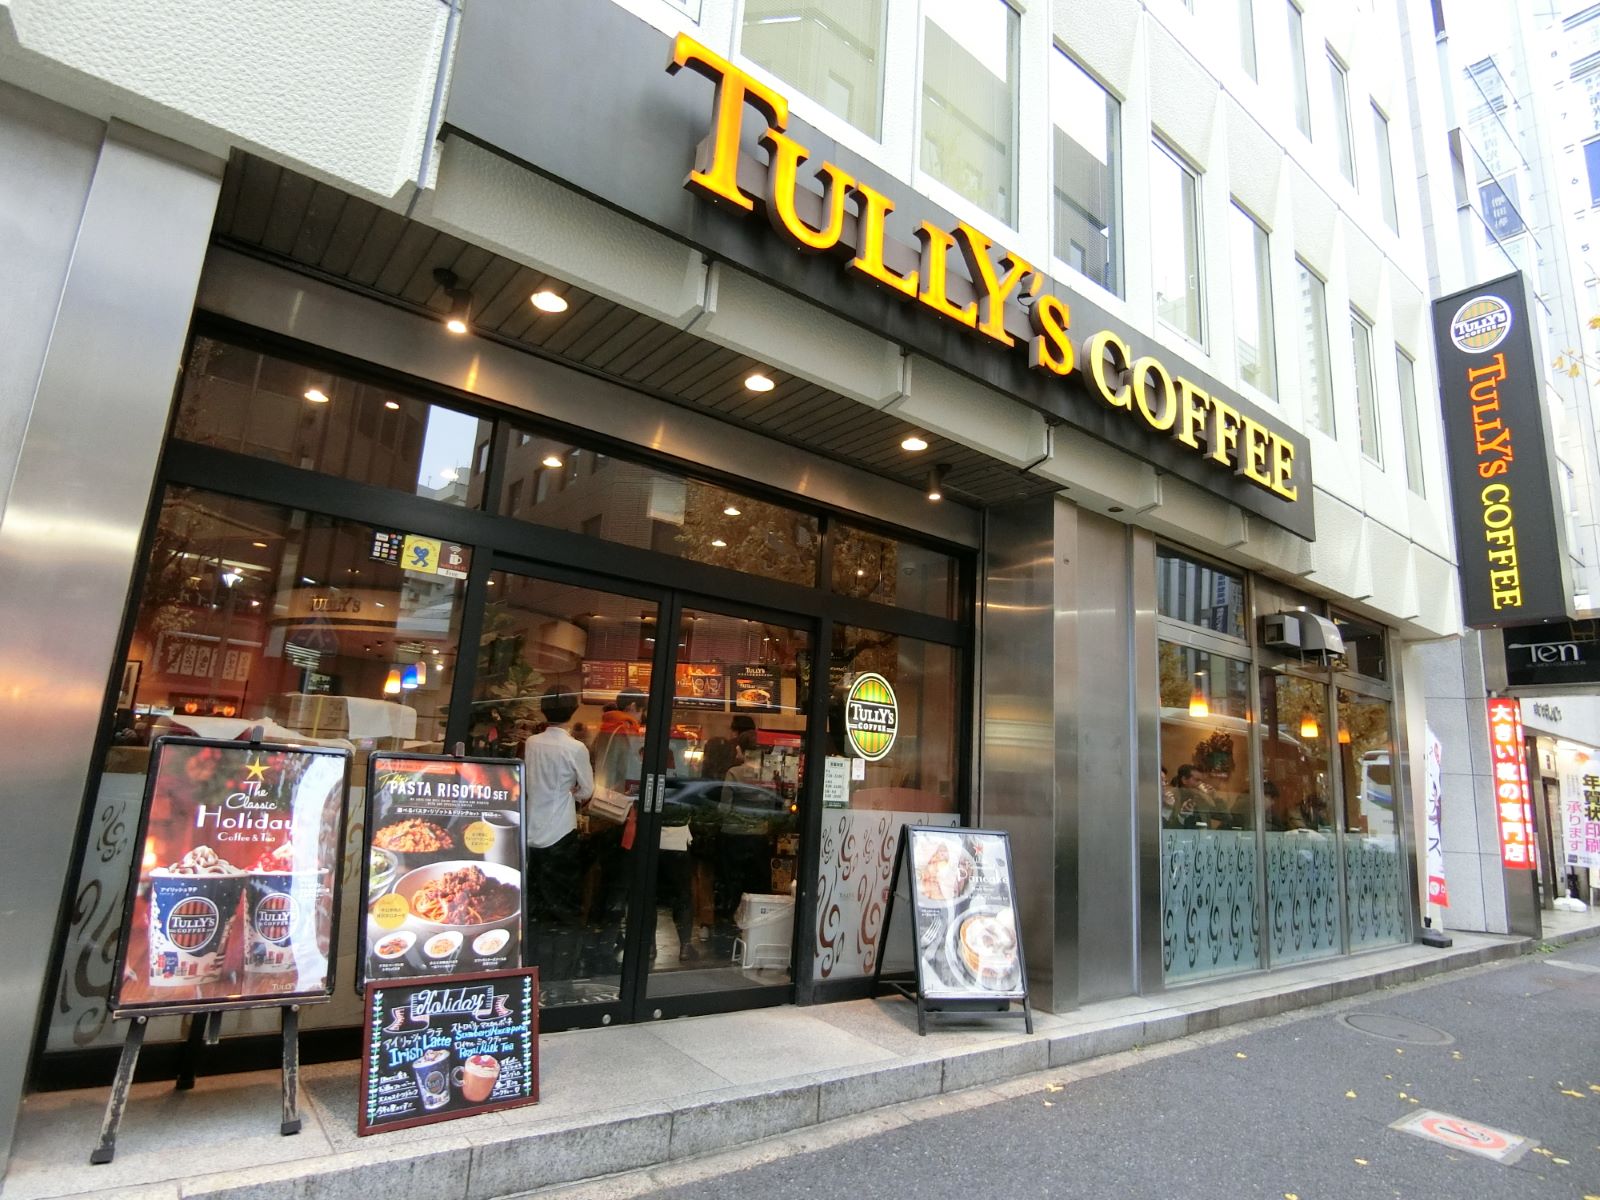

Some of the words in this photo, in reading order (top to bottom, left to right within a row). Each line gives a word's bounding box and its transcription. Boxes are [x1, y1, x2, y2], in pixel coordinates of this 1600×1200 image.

[666, 33, 1074, 375] TULLY'S
[1084, 331, 1298, 503] COFFEE
[1468, 353, 1513, 479] TULLY'S
[1481, 483, 1522, 610] COFFEE
[1508, 641, 1582, 663] Ten
[850, 703, 894, 725] TULLY'S
[858, 722, 887, 732] COFFEE
[243, 780, 268, 797] The
[390, 781, 431, 796] PASTA
[437, 783, 492, 799] RISOTTO
[493, 791, 509, 800] SET
[226, 793, 277, 810] Classic
[217, 832, 250, 842] Coffee
[251, 832, 259, 842] &
[1567, 800, 1583, 852] 承ります
[171, 916, 215, 929] TULLY'S
[416, 987, 485, 1015] Holiday
[388, 1041, 423, 1067] Irish
[422, 1034, 452, 1050] Latte
[500, 1041, 514, 1052] Tea
